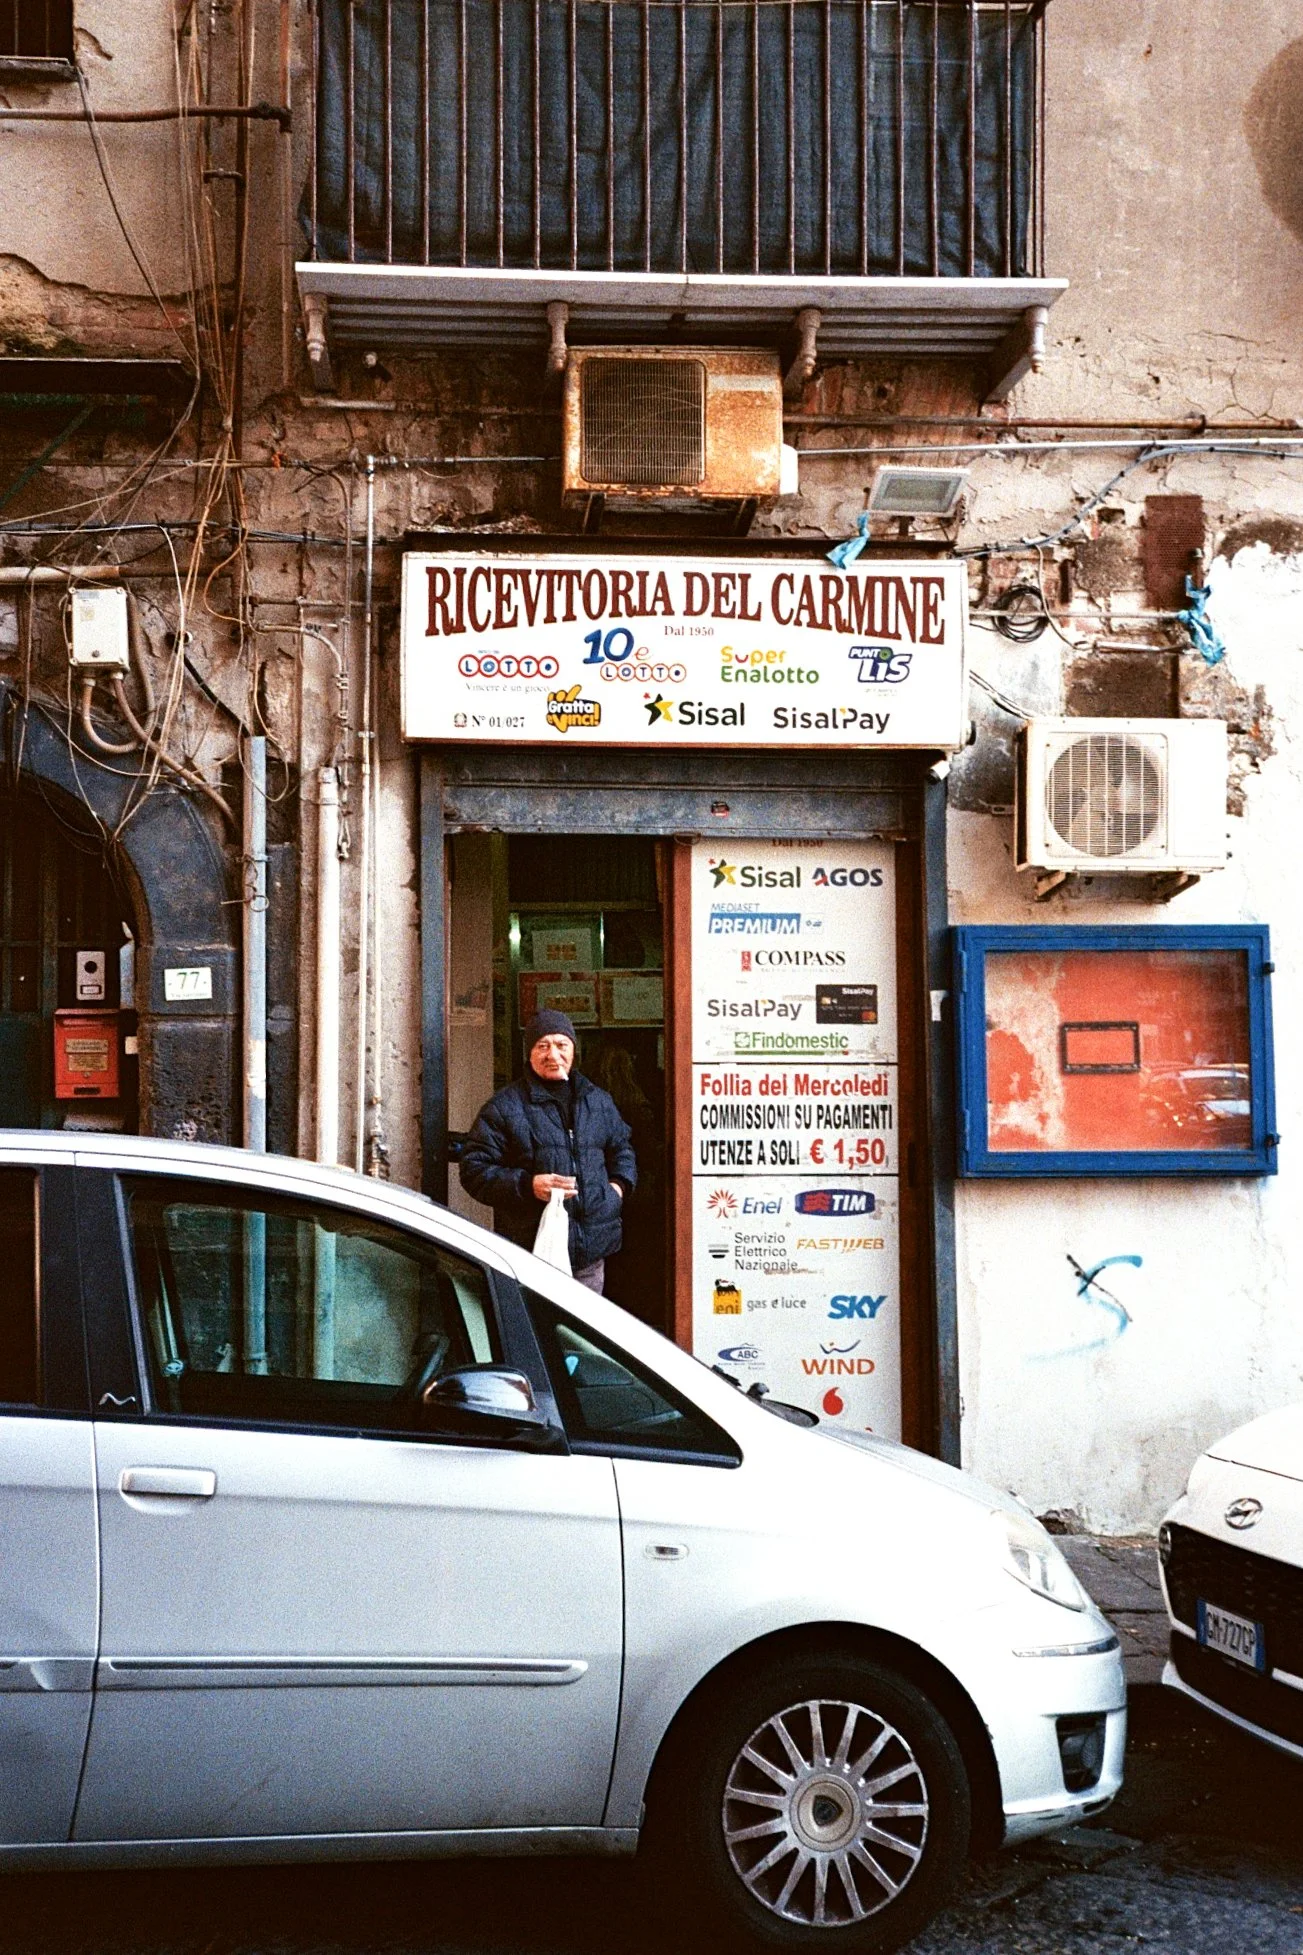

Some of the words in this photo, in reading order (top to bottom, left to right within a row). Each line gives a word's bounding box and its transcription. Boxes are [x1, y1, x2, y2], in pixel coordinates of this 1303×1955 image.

[425, 566, 675, 636] RICEVITORIA
[683, 572, 761, 621] DEL
[771, 573, 944, 645] CARMINE
[664, 626, 684, 636] Dal
[690, 627, 714, 636] 1950
[583, 627, 634, 664] 10
[721, 646, 786, 666] Super
[461, 657, 556, 676] LOTTO
[601, 664, 685, 681] LOTTO
[721, 666, 819, 684] Enalotto
[465, 683, 500, 692] Vincere
[548, 700, 595, 714] Gratta
[678, 701, 745, 726] Sisal
[773, 706, 890, 734] SisalPay
[740, 865, 801, 888] Sisal
[812, 867, 883, 887] AGOS
[711, 902, 760, 912] MEDIASET
[710, 917, 799, 934] PREMIUM
[755, 950, 846, 966] COMPASS
[177, 971, 200, 990] 77
[707, 999, 802, 1020] SisalPay
[751, 1032, 848, 1048] Findomestic
[700, 1073, 752, 1096] Follia
[700, 1104, 790, 1129] COMMISSIONI
[794, 1104, 812, 1129] SU
[816, 1104, 892, 1129] PAGAMENTI
[700, 1140, 753, 1165] UTENZE
[757, 1140, 766, 1165] A
[770, 1140, 800, 1165] SOLI
[809, 1138, 824, 1164] €
[833, 1138, 885, 1169] 1,50
[742, 1197, 783, 1214] Enel
[832, 1194, 866, 1211] TIM
[734, 1232, 785, 1244] Servizio
[796, 1238, 885, 1251] FASTWEB
[734, 1246, 787, 1257] Elettrico
[734, 1259, 798, 1271] Nazionale
[715, 1300, 739, 1314] eni
[747, 1299, 767, 1311] gas
[781, 1296, 807, 1309] luce
[738, 1350, 758, 1358] ABC
[801, 1359, 875, 1375] WIND
